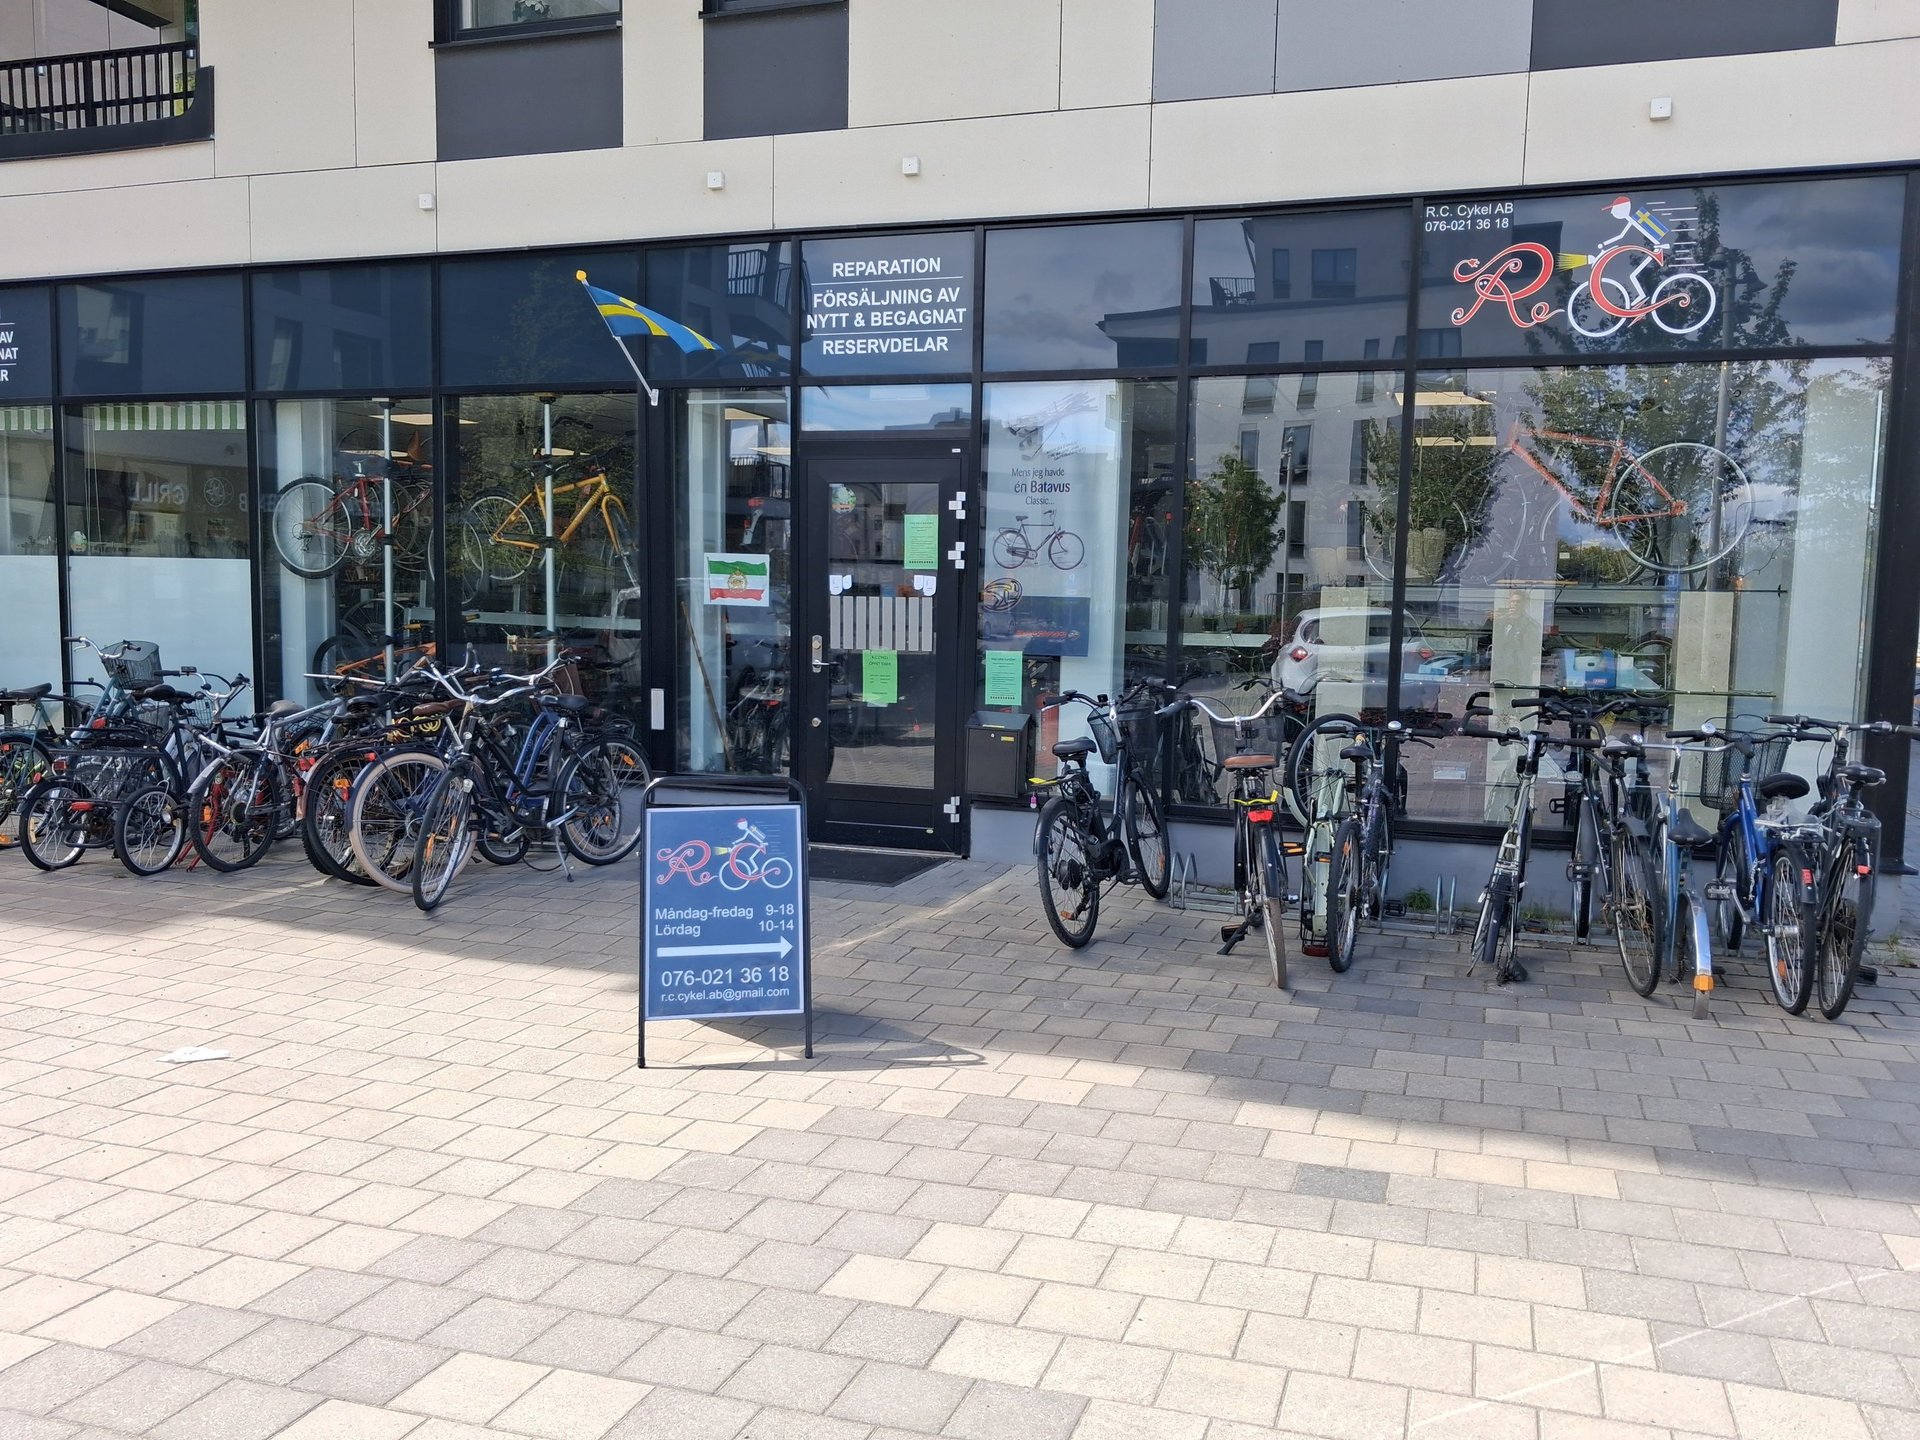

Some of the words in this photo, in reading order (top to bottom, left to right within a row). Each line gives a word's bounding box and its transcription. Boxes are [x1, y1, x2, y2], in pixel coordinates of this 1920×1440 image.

[1426, 205, 1453, 218] R.C.
[1457, 203, 1492, 218] Cykel
[1494, 202, 1514, 214] AB
[1425, 220, 1471, 232] 076-021
[1476, 218, 1491, 230] 36
[1495, 217, 1509, 229] 18
[832, 257, 941, 278] REPARATION
[813, 288, 933, 309] FÖRSÄLJNING
[937, 287, 960, 303] AV
[806, 312, 850, 329] NYTT
[854, 312, 866, 327] &
[870, 308, 967, 327] BEGAGNAT
[822, 336, 949, 355] RESERVDELAR
[1011, 468, 1031, 477] Mens
[1032, 467, 1044, 479] jeg
[1044, 467, 1065, 477] havde
[1030, 480, 1071, 493] Batavus
[655, 905, 754, 921] Måndag-fredag
[765, 904, 794, 916] 9-18
[655, 923, 701, 937] Lördag
[759, 920, 794, 932] 10-14
[661, 968, 733, 987] 076-021
[740, 967, 762, 984] 36
[769, 966, 790, 982] 18
[661, 987, 790, 1003] r.c.cykel.ab@gmail.com
